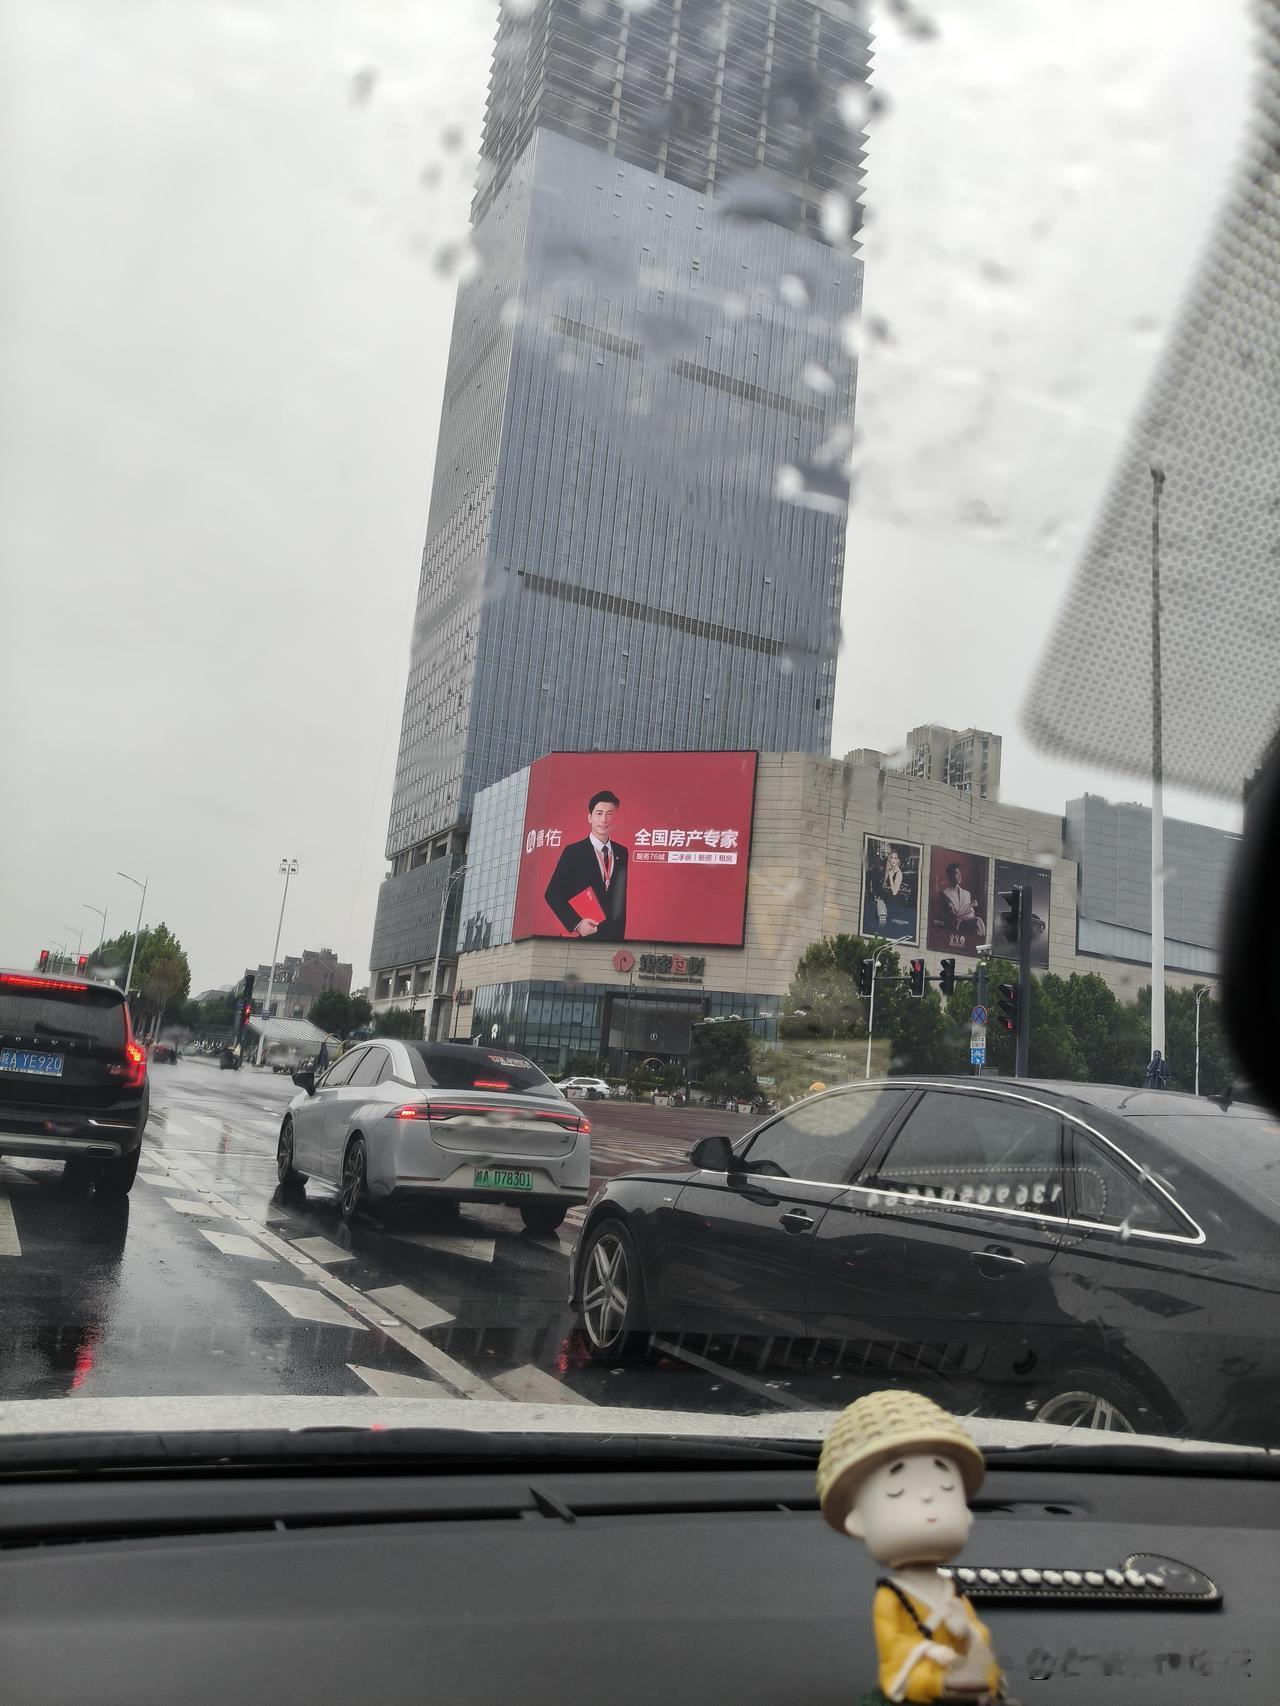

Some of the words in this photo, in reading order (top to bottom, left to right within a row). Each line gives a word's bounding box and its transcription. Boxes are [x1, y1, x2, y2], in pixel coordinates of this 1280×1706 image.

[634, 828, 739, 849] 全国房产专家
